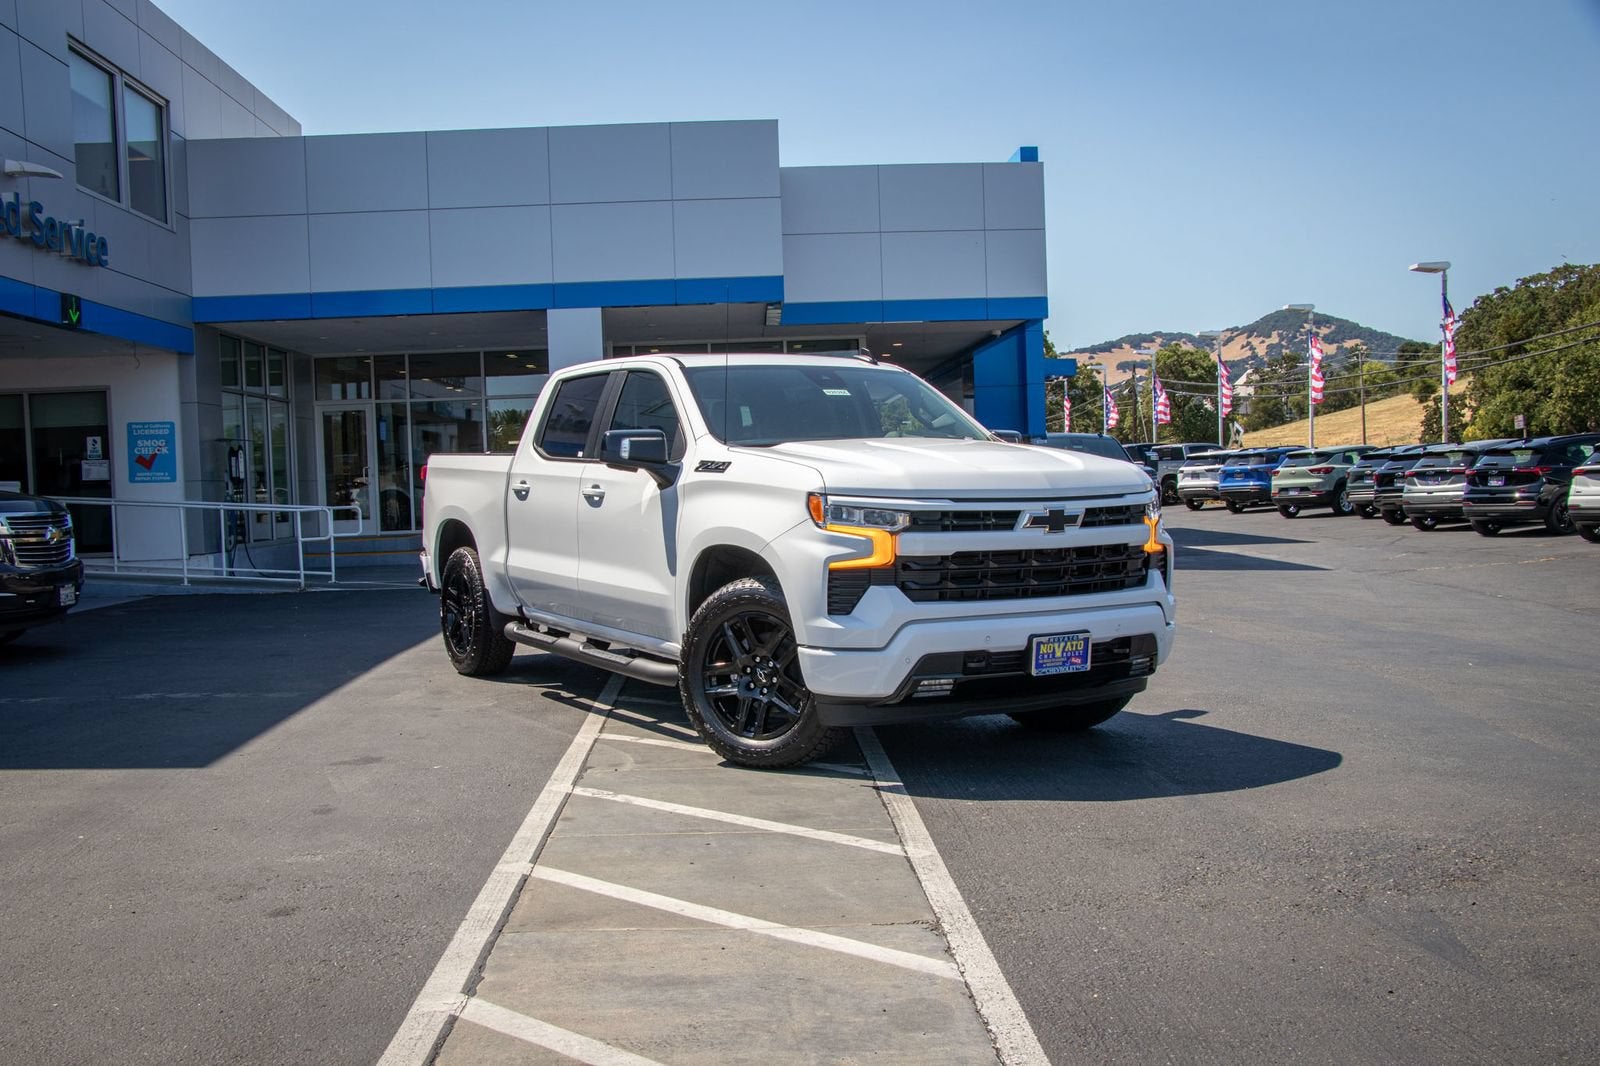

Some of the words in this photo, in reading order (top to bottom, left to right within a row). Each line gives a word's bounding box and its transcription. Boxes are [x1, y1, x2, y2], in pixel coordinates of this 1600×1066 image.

[30, 201, 109, 267] Service
[137, 439, 166, 447] SMOG
[134, 446, 169, 454] CHECK
[1040, 640, 1084, 657] NOVATO
